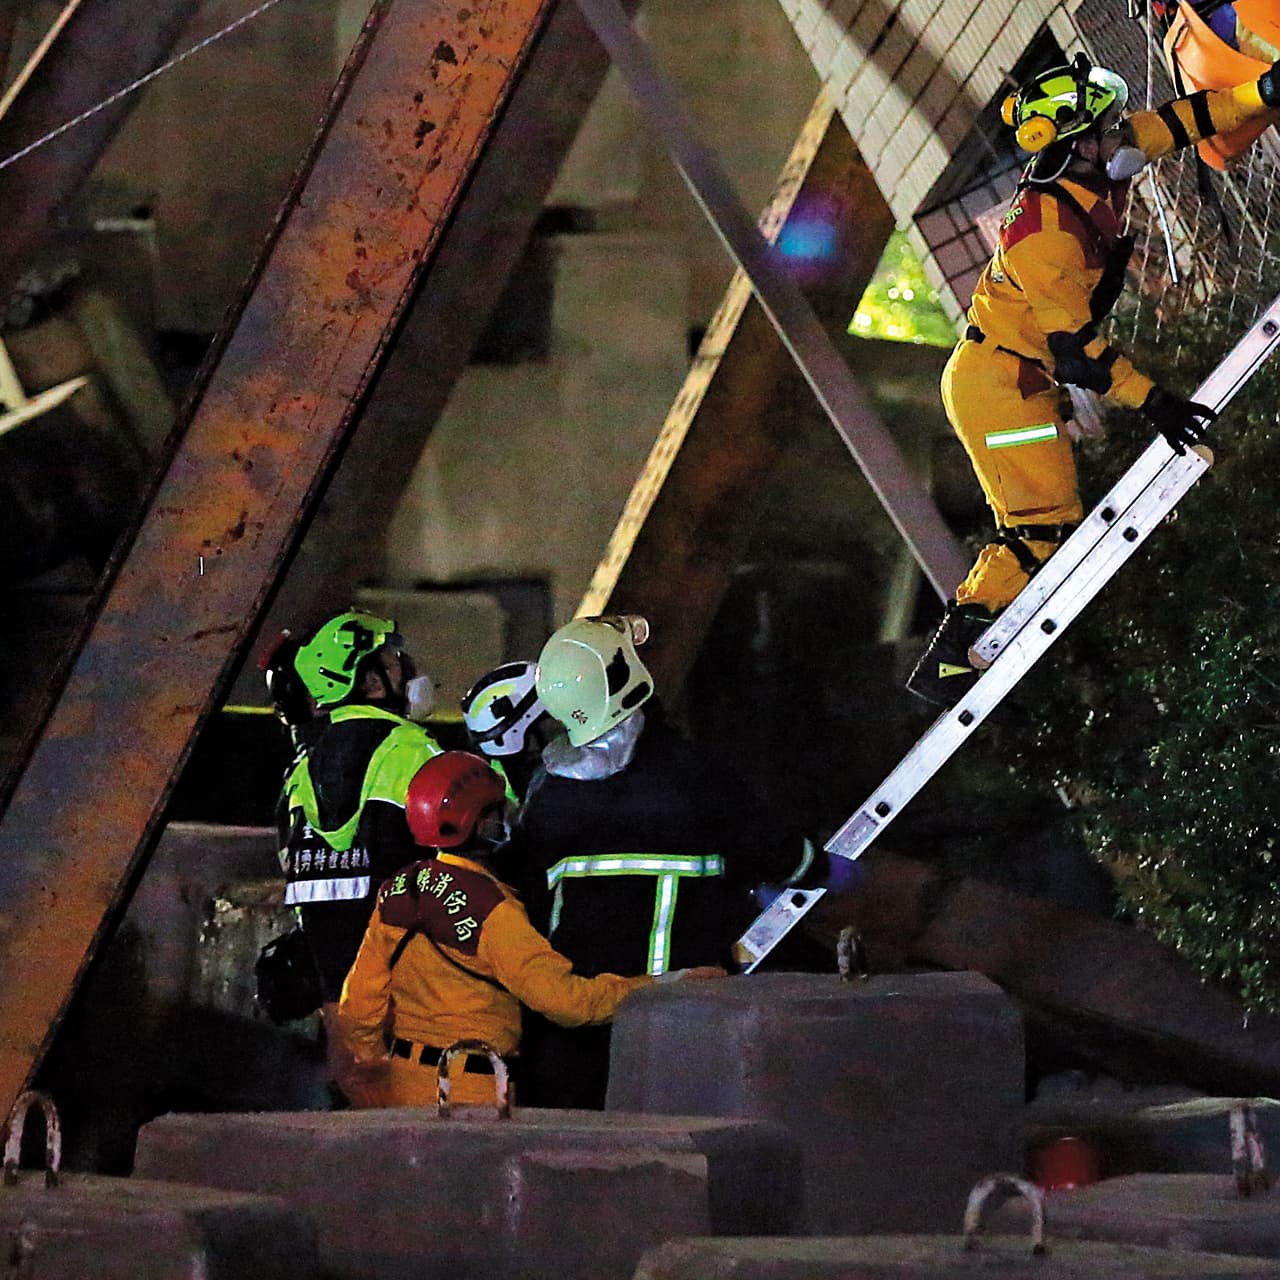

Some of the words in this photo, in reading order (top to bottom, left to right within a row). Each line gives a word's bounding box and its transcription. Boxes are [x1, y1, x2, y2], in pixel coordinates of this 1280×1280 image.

[379, 867, 478, 942] 蓮縣消防局
